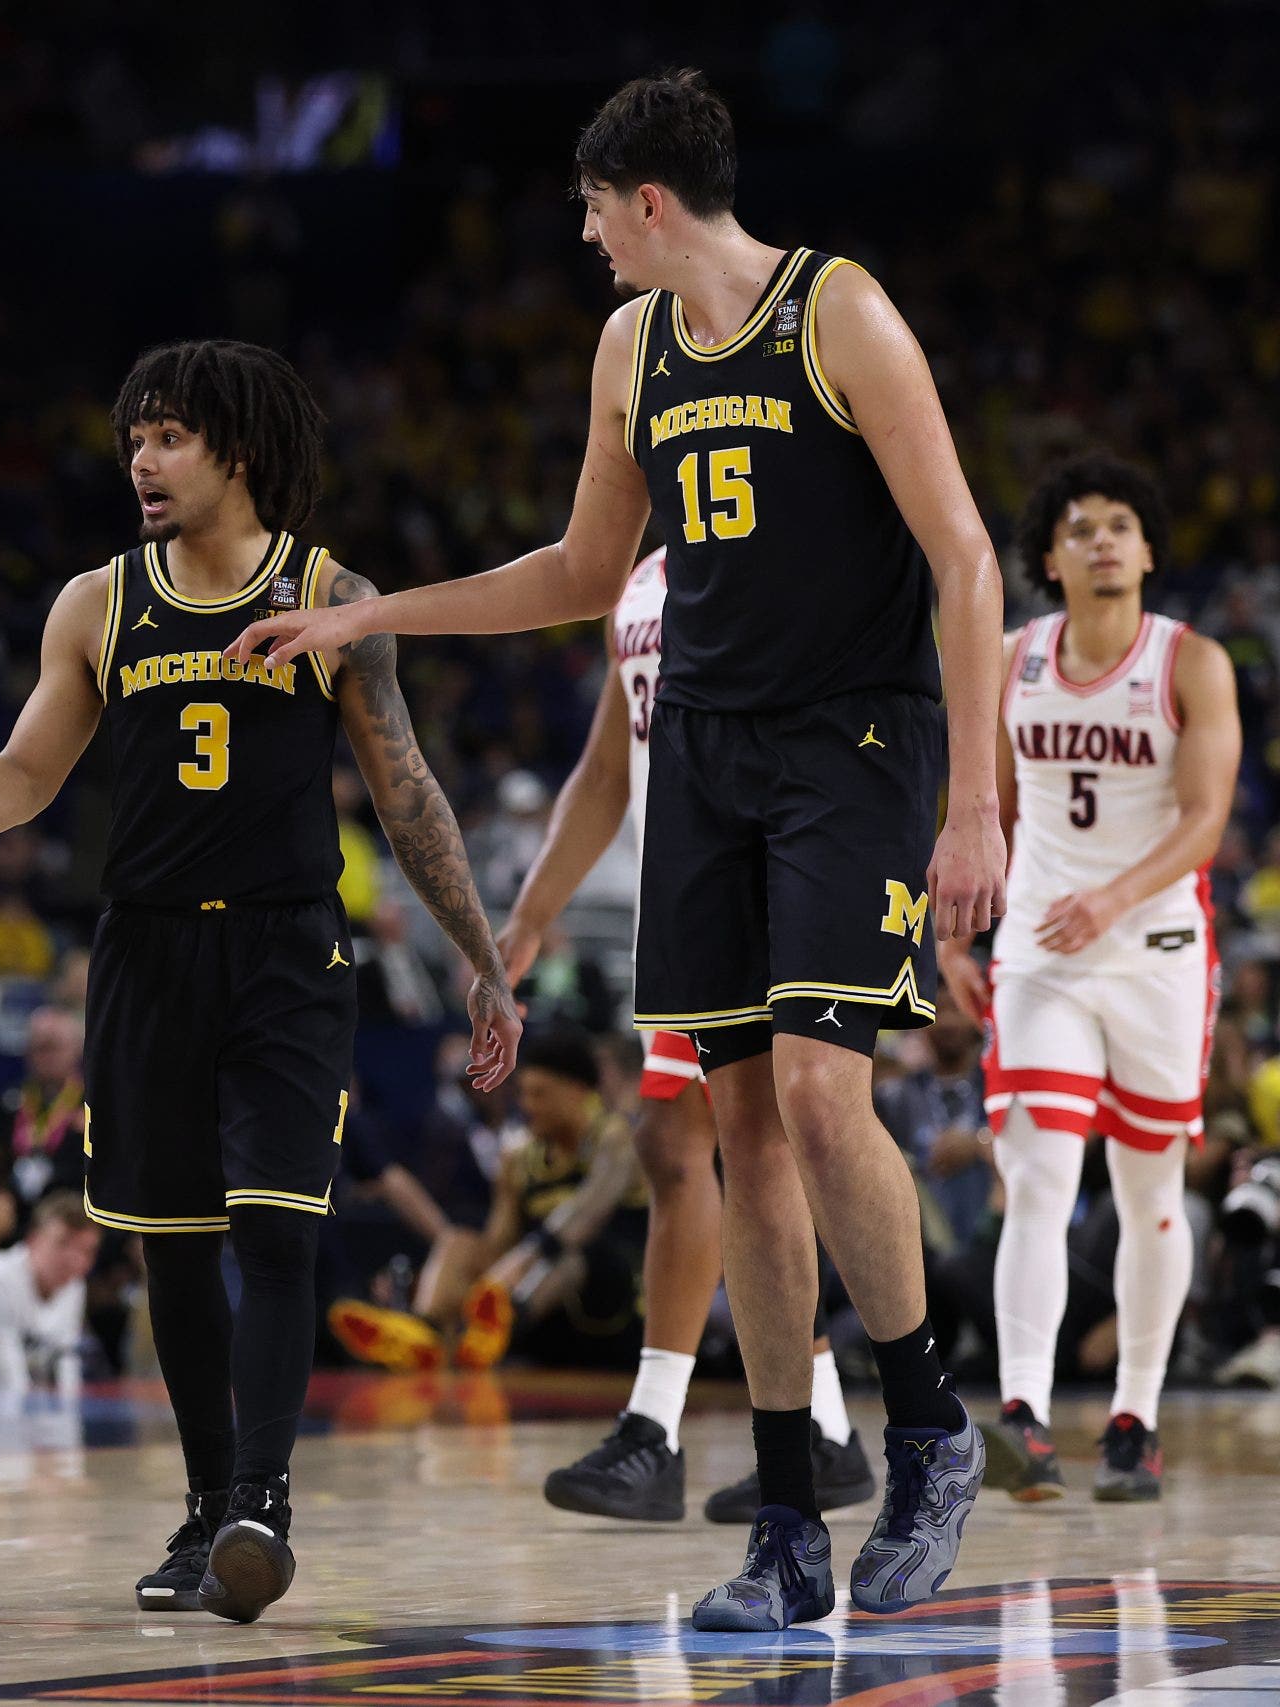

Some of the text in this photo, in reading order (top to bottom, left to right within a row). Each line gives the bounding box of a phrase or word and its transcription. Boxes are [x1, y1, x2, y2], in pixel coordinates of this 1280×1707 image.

[777, 304, 799, 316] FINAL
[777, 320, 798, 331] FOUR
[649, 395, 794, 450] MICHIGAN
[677, 446, 757, 544] 15
[272, 595, 296, 604] FOUR
[273, 581, 296, 591] FINAL
[120, 651, 297, 699] MICHIGAN
[178, 702, 230, 791] 3
[1069, 771, 1099, 829] 5
[880, 879, 929, 949] M
